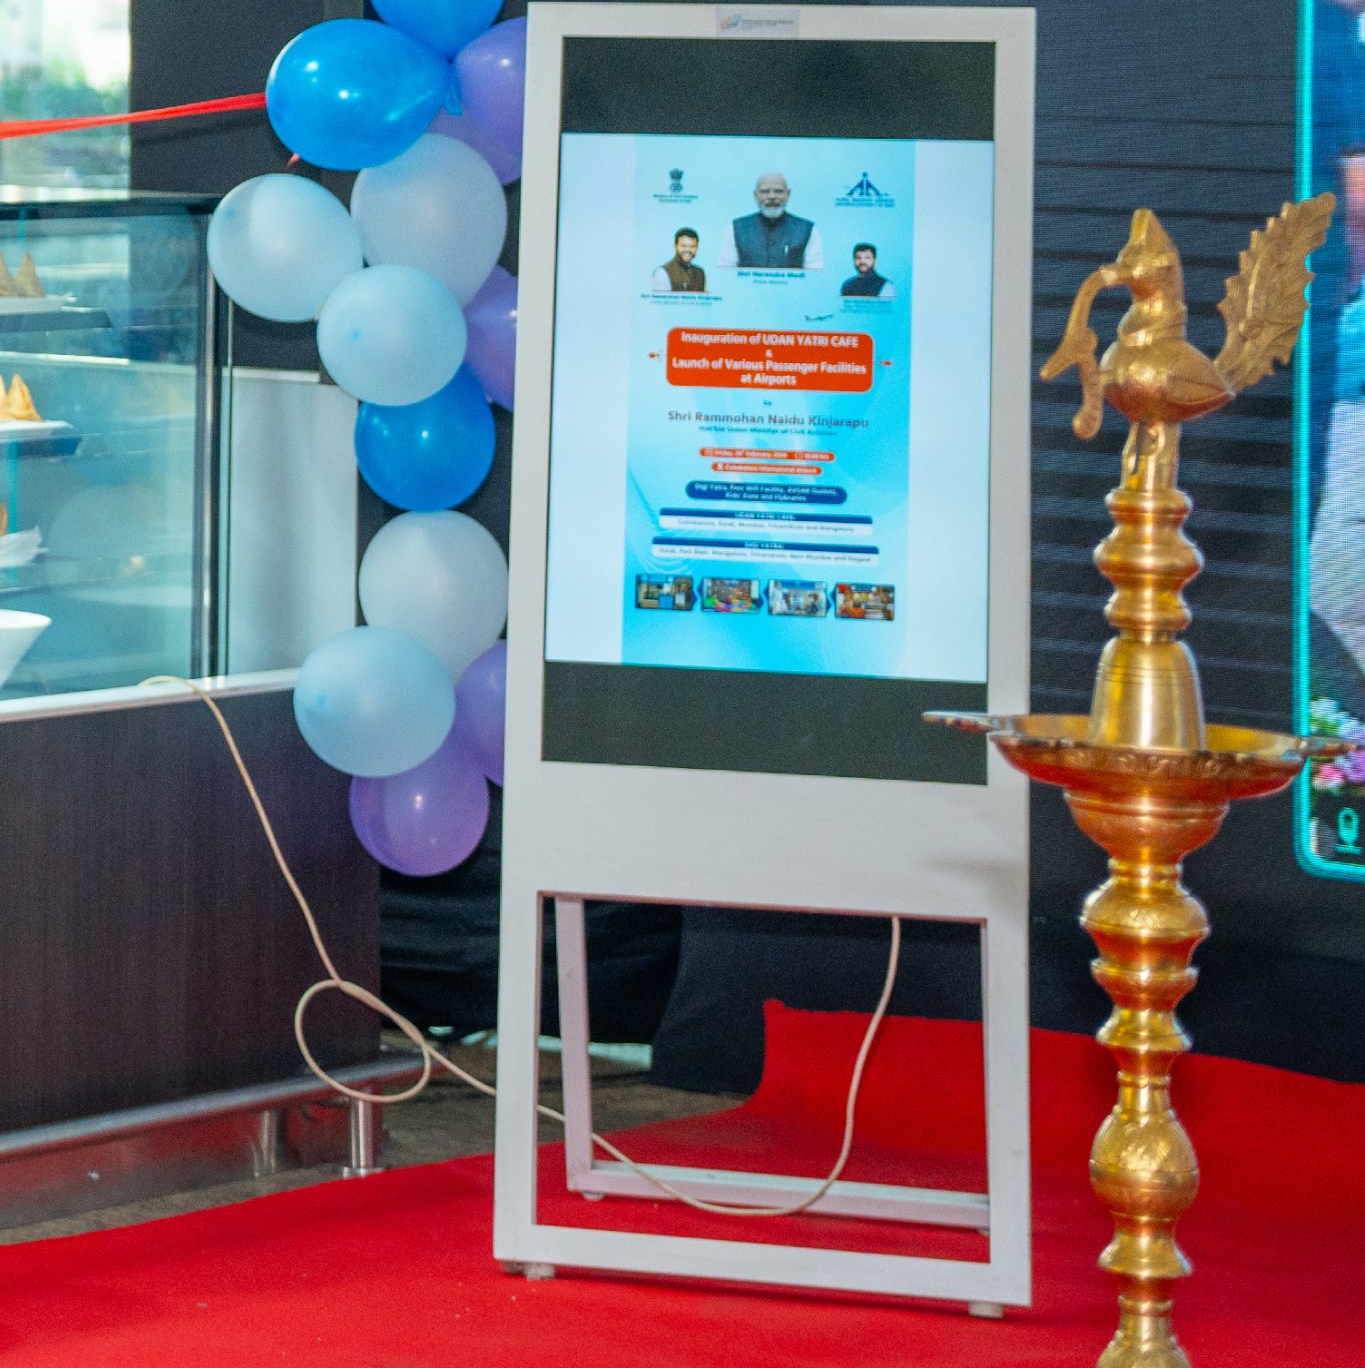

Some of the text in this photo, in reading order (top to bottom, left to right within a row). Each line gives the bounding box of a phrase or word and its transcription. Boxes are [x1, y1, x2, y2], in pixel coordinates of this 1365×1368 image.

[681, 331, 859, 349] Inauguration of UDAN YATRI CAFE
[672, 357, 867, 375] Launch of Various Passenger Facilities
[740, 373, 797, 386] at Airports
[668, 410, 870, 430] Shri Rammohan Naidu Kinjarapu
